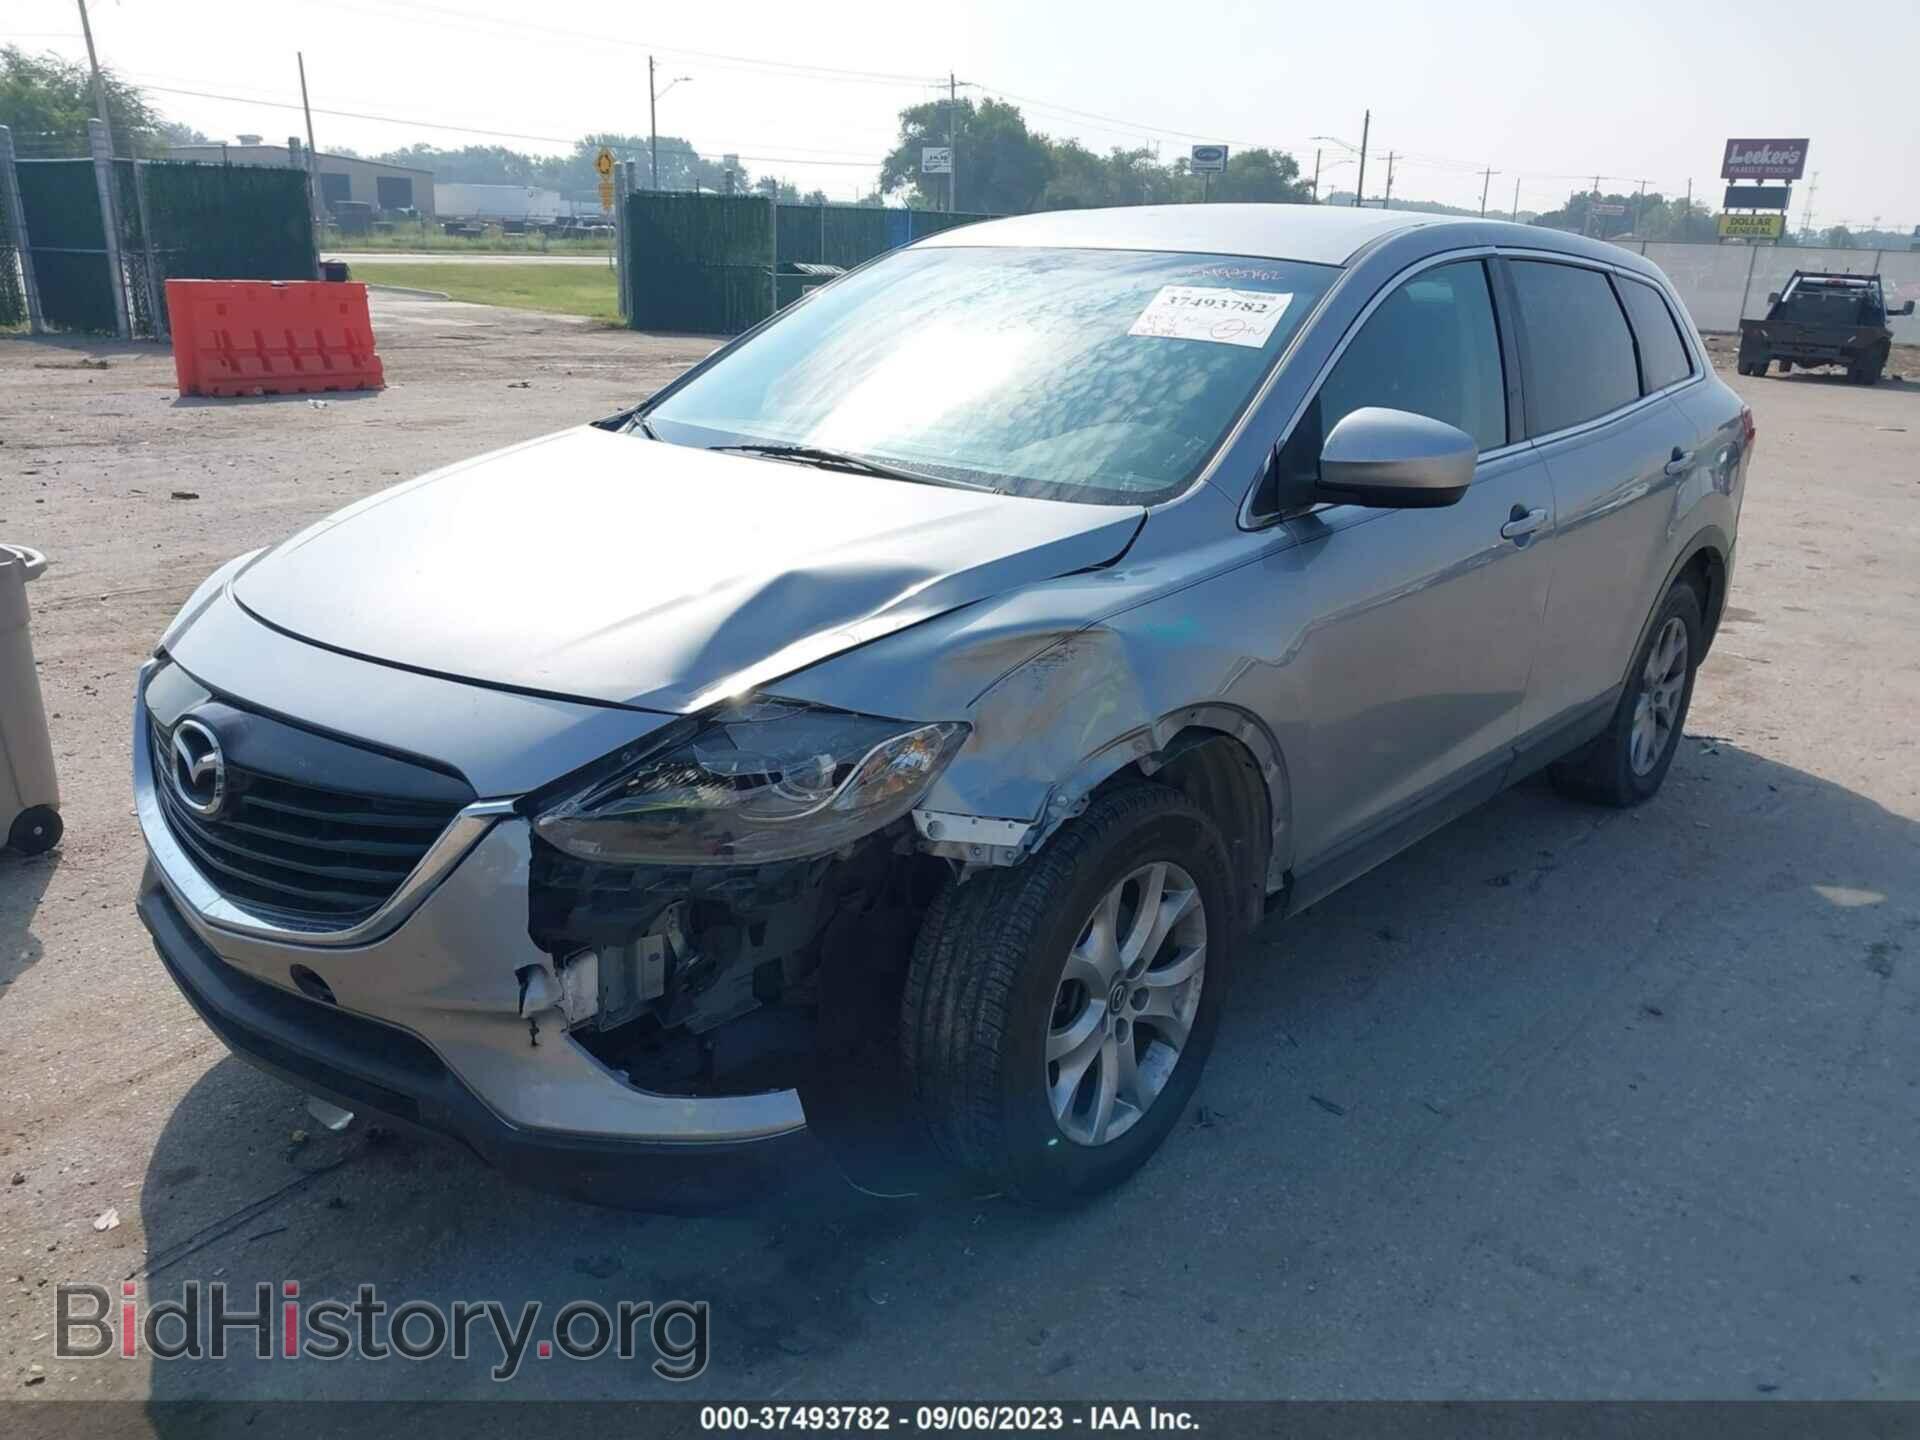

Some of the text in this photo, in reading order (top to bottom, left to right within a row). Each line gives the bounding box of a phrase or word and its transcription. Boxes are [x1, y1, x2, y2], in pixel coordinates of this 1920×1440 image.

[1728, 144, 1801, 166] Leeker's
[1730, 217, 1772, 226] DOLLAR
[1726, 226, 1771, 235] GENERAL
[1168, 296, 1269, 314] 37493782
